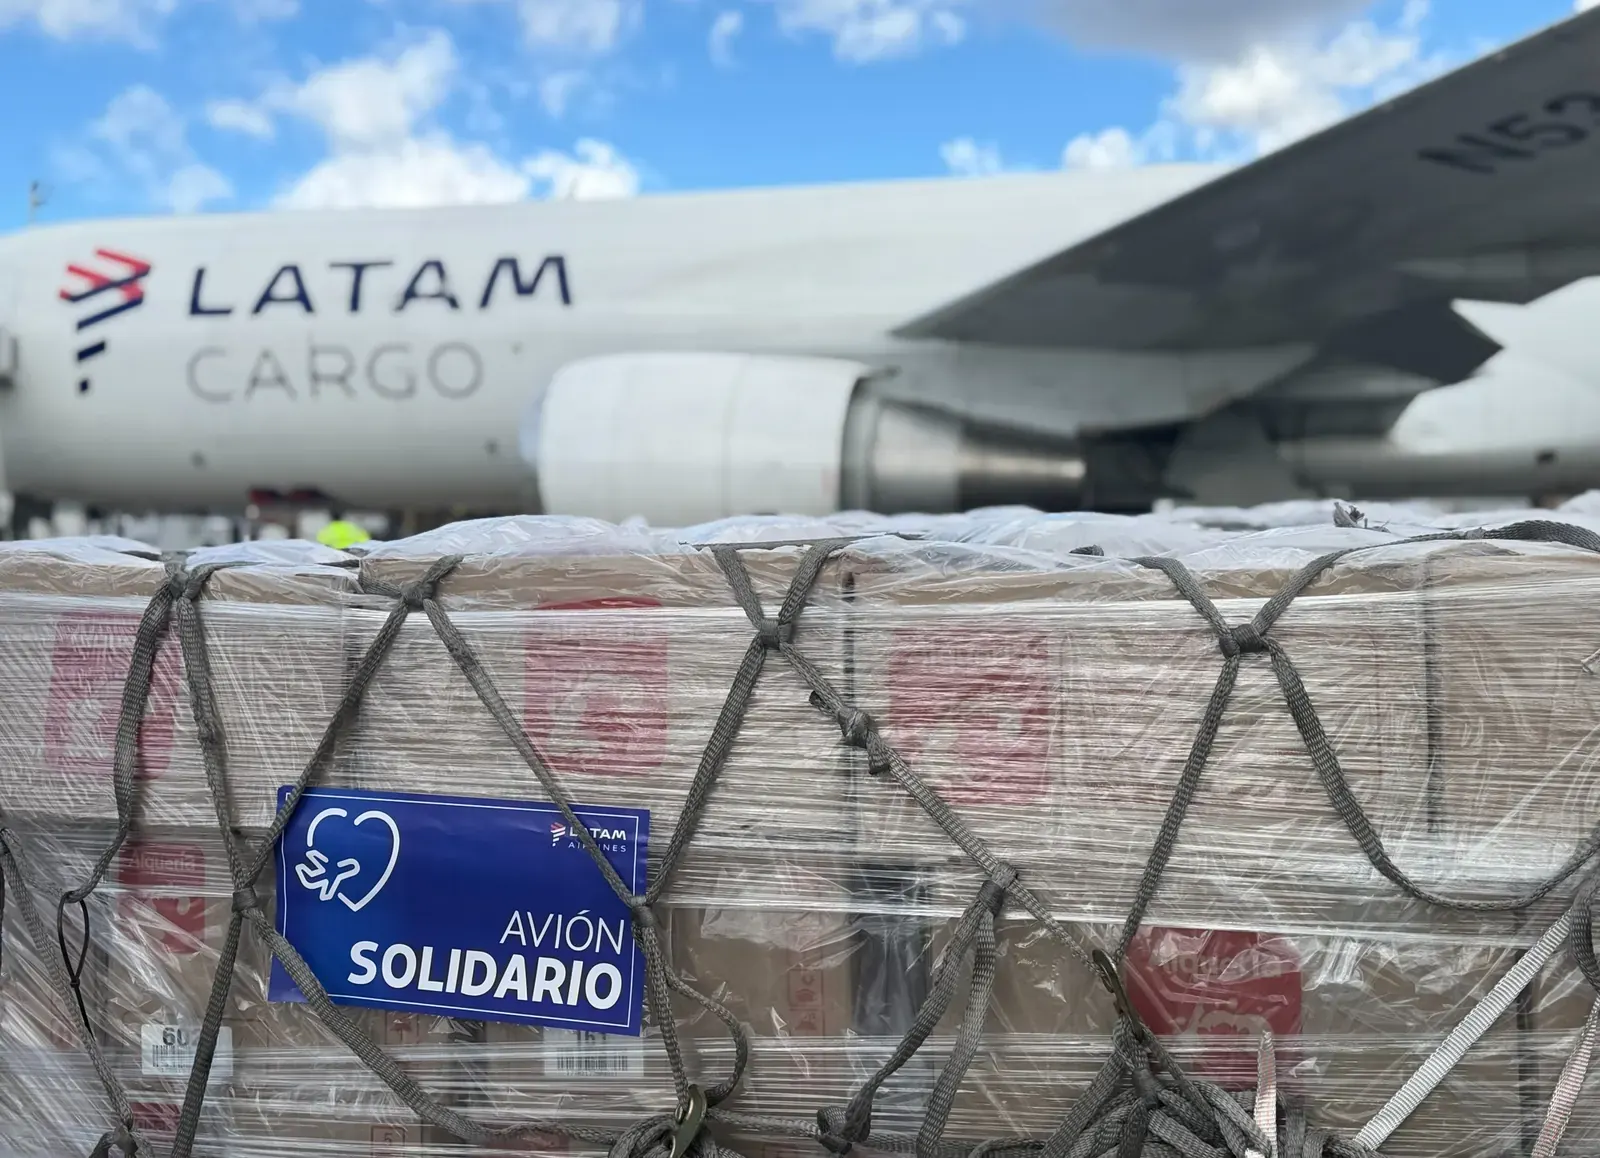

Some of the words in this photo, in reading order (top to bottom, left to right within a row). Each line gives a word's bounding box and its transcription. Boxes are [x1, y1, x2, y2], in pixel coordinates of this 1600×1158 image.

[187, 255, 572, 316] LATAM
[186, 341, 484, 402] CARGO
[569, 826, 627, 840] LTAM
[499, 909, 625, 955] AVIÓN
[347, 940, 623, 1010] SOLIDARIO
